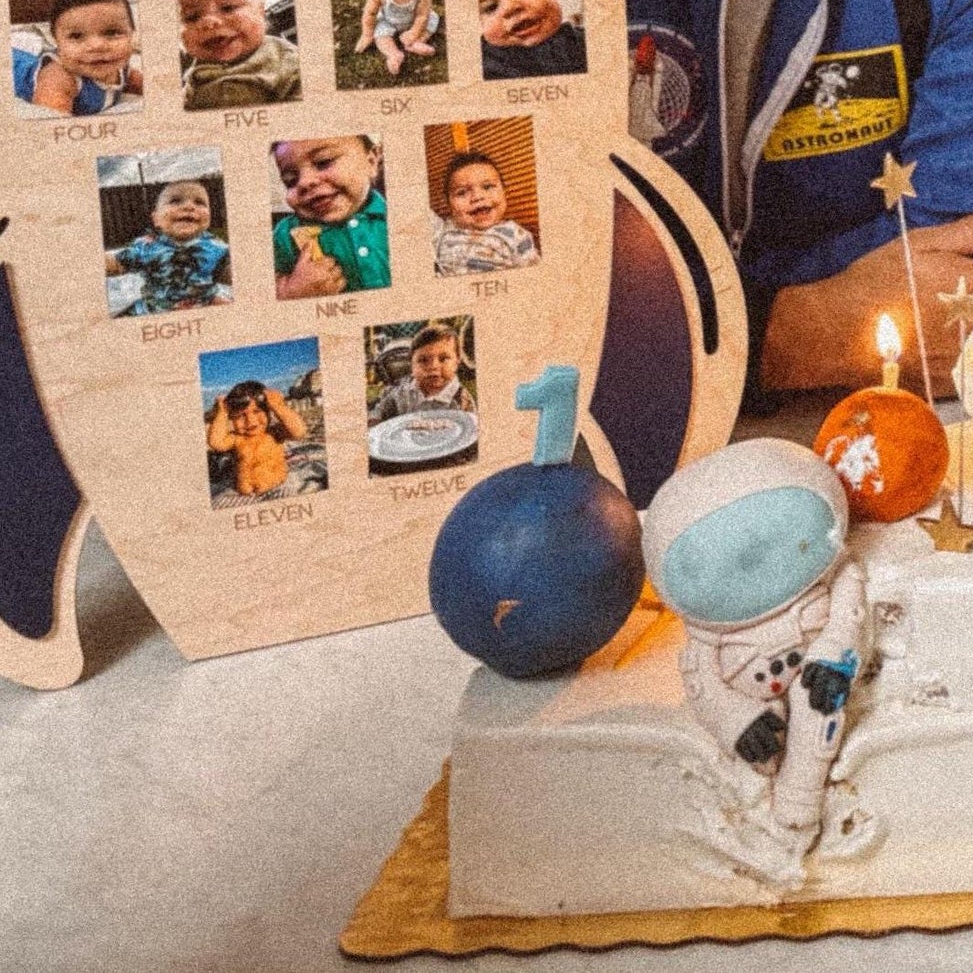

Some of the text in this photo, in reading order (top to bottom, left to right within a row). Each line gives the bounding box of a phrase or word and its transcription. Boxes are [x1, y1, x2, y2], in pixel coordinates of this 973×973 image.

[506, 85, 568, 103] SEVEN
[381, 97, 413, 115] SIX
[225, 110, 268, 128] FIVE
[53, 122, 117, 143] FOUR
[782, 117, 893, 152] ASTRONAUT
[471, 280, 508, 298] TEN
[316, 299, 357, 318] NINE
[142, 319, 202, 342] EIGHT
[514, 364, 580, 465] 1
[390, 475, 467, 501] TWELVE
[235, 503, 313, 529] ELEVEN
